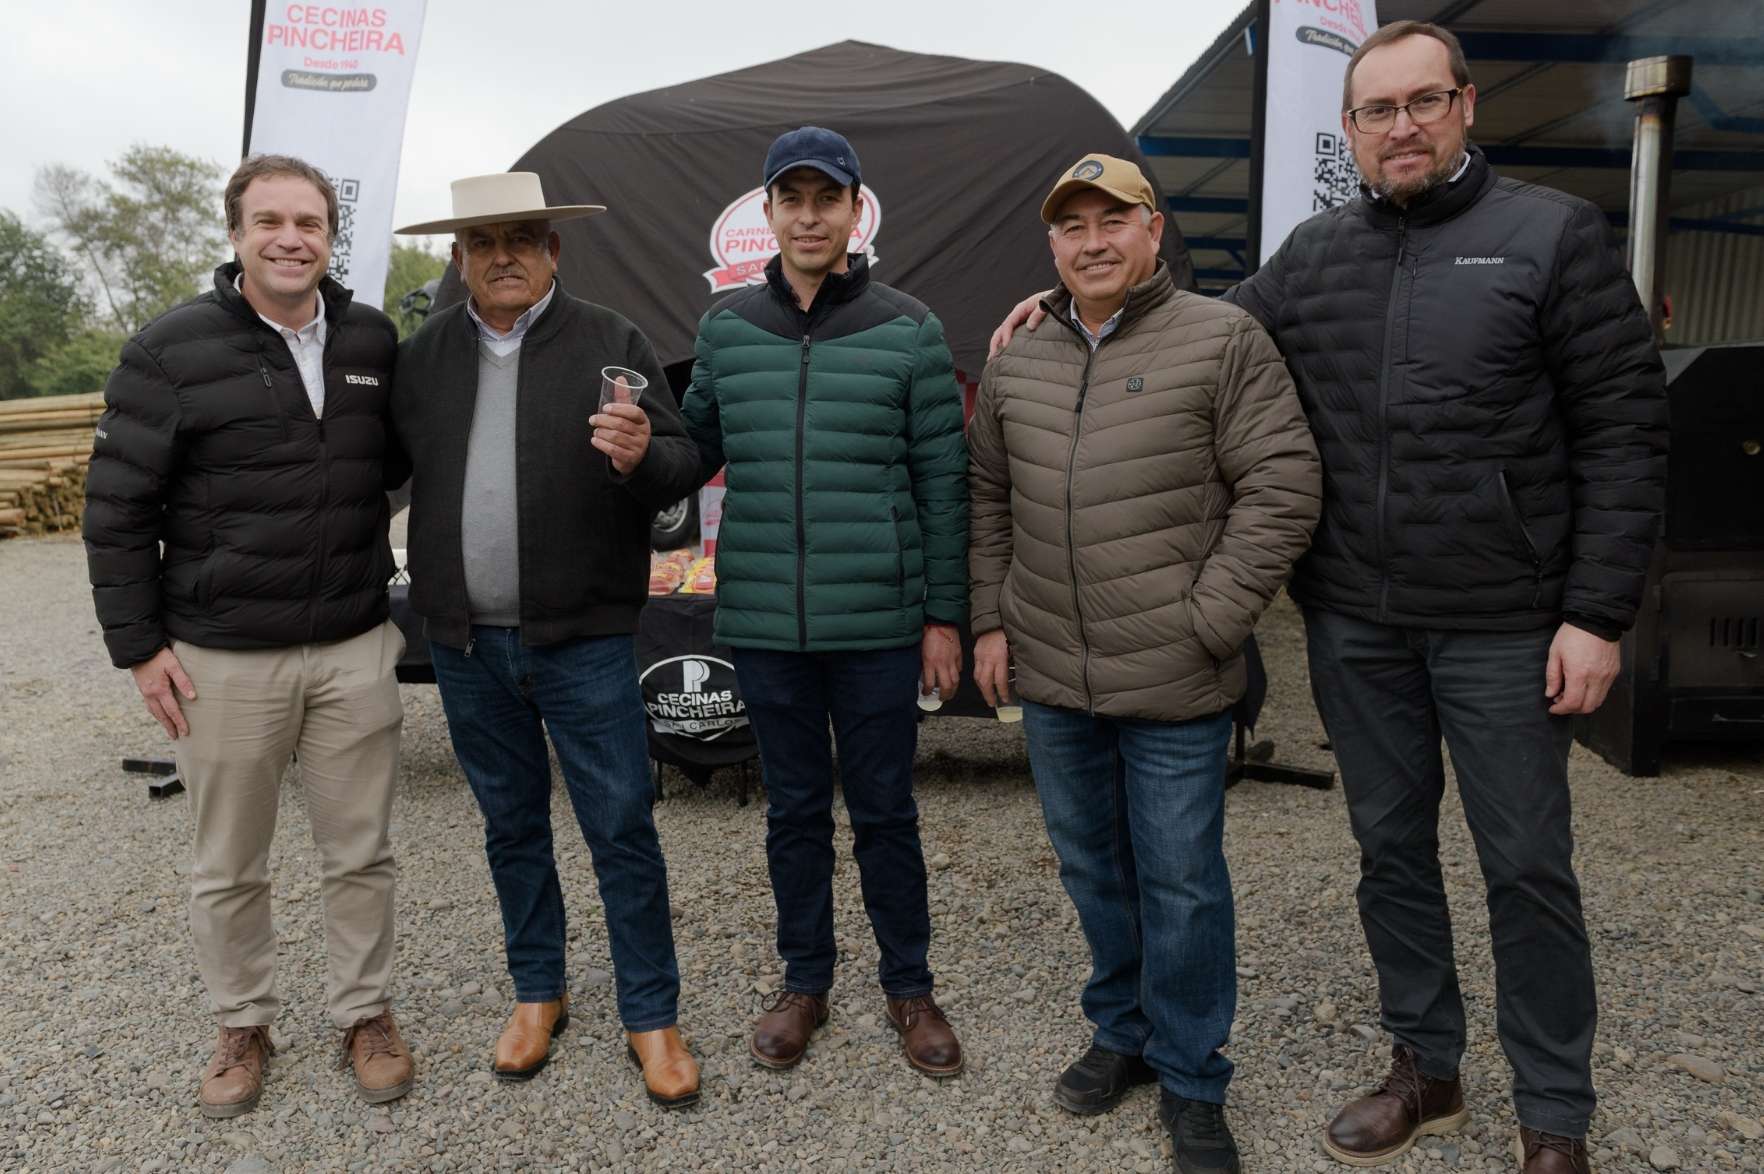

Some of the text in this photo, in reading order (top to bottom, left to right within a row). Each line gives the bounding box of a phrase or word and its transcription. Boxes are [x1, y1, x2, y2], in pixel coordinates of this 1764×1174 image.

[287, 4, 387, 28] CECINAS
[267, 24, 405, 55] PINCHEIRA
[304, 56, 338, 70] Desde
[345, 374, 379, 386] ISUZU
[657, 690, 733, 706] CECINAS
[647, 700, 746, 718] PINCHEIRA
